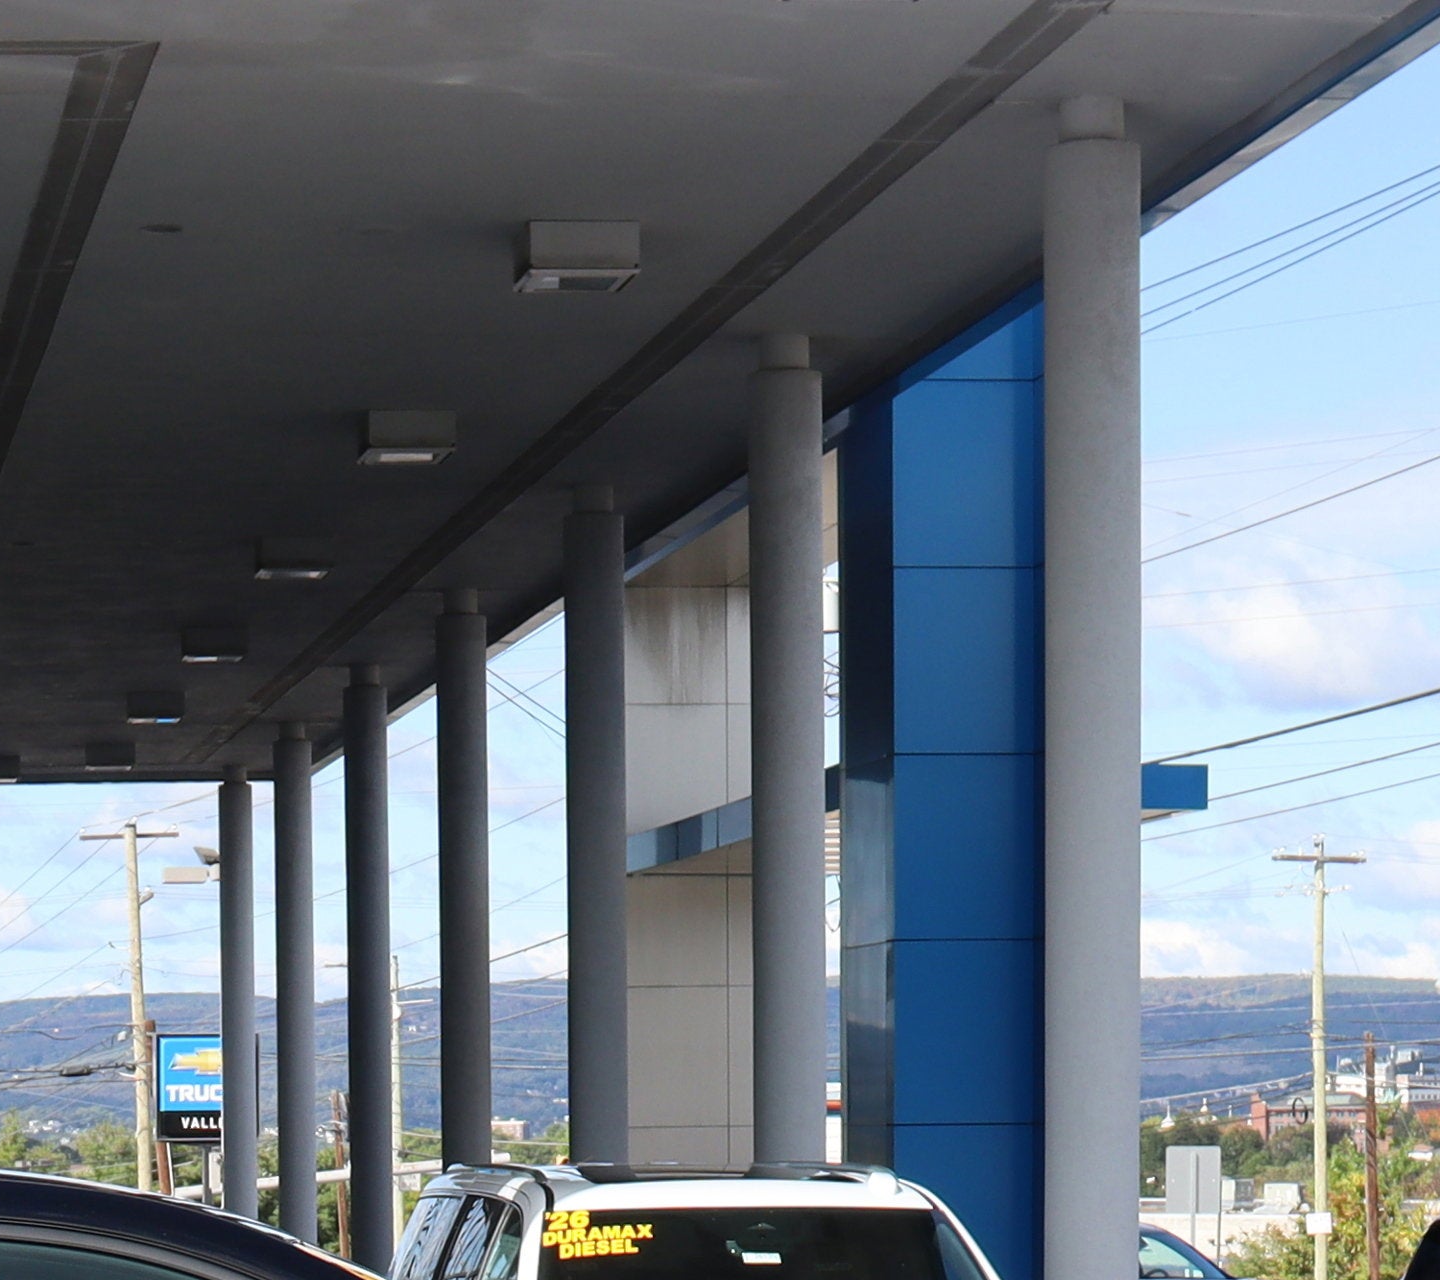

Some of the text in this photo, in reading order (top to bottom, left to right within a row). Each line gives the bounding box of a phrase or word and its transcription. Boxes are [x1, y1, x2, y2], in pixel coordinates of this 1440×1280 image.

[545, 1210, 590, 1231] '26
[542, 1224, 653, 1248] DURAMAX
[559, 1238, 639, 1260] DIESEL
